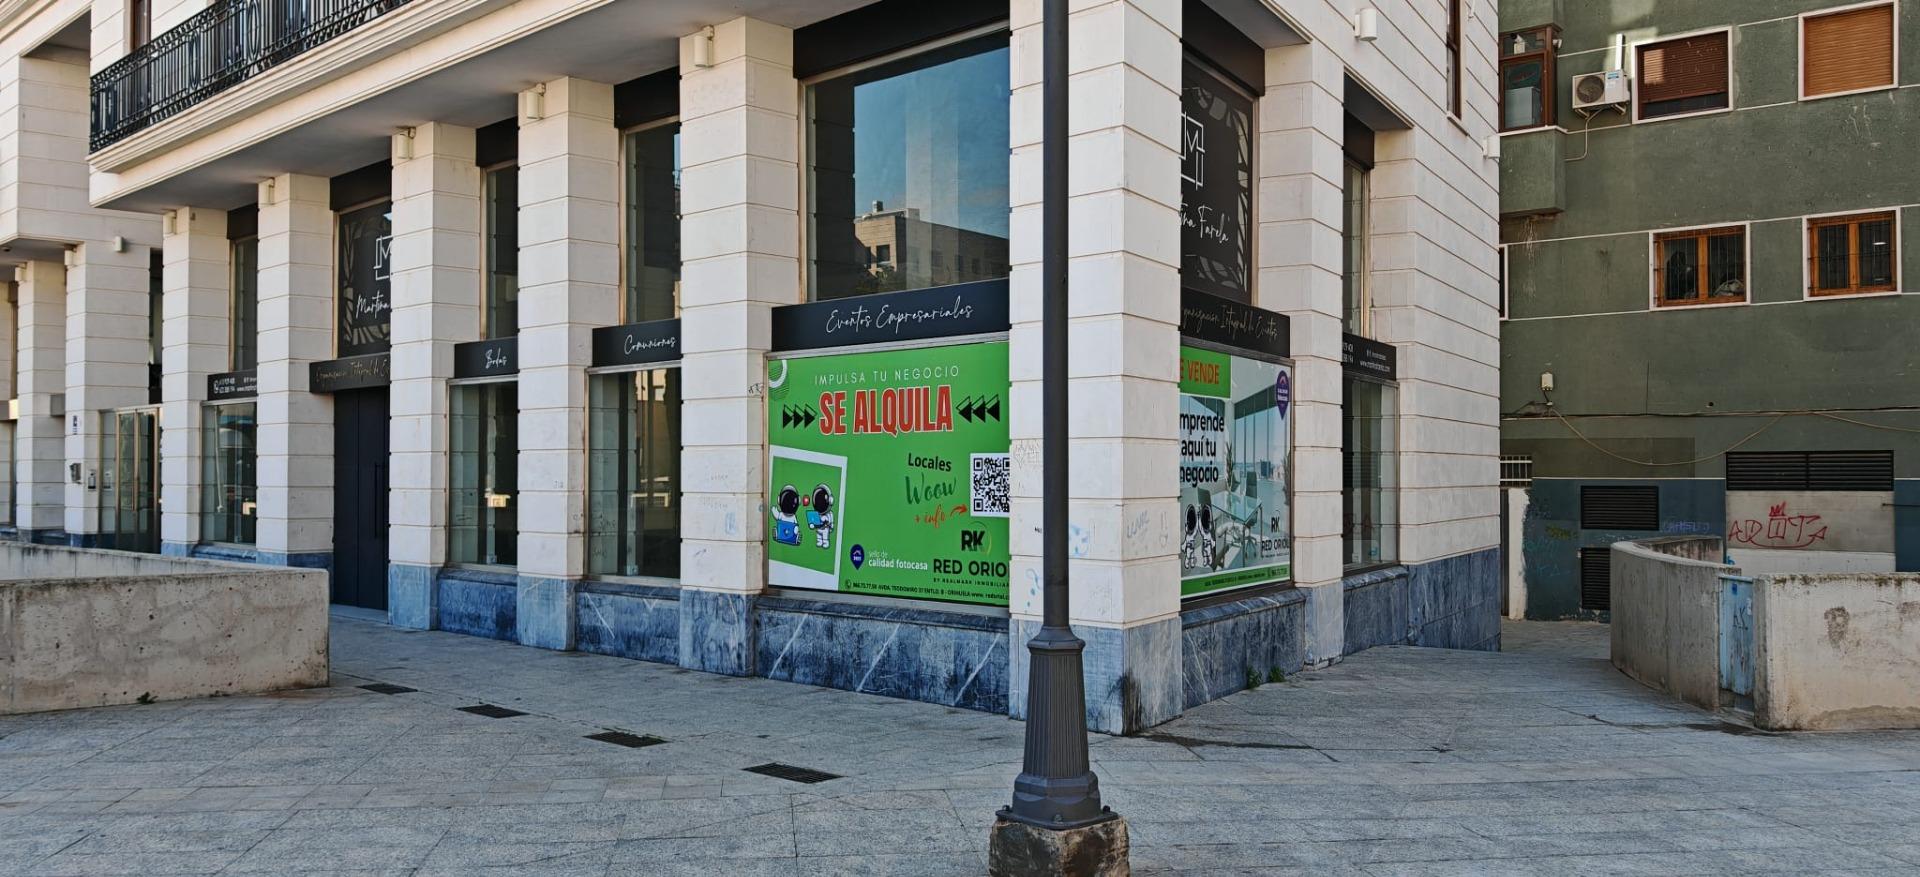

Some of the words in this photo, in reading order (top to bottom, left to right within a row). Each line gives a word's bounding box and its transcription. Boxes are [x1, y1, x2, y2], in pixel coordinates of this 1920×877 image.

[825, 304, 873, 333] Eventos
[875, 295, 974, 334] Empresariales
[624, 334, 676, 355] Comuniones
[485, 347, 507, 369] Bodas
[814, 372, 866, 386] IMPULSA
[873, 370, 887, 382] TU
[894, 365, 960, 381] NEGOCIO
[1187, 360, 1220, 385] VENDE
[819, 391, 847, 435] SE
[853, 384, 955, 438] ALQUILA
[1180, 412, 1225, 435] mprende
[1181, 435, 1204, 461] aquí
[1205, 441, 1217, 457] tu
[908, 453, 952, 472] Locales
[905, 472, 957, 505] Woow
[924, 503, 945, 528] info
[1271, 516, 1280, 533] RK
[961, 530, 985, 551] RK
[1261, 539, 1272, 551] RED
[868, 559, 894, 568] calidad
[896, 559, 928, 571] fotocasa
[933, 558, 963, 575] RED
[968, 560, 1009, 578] ORIO
